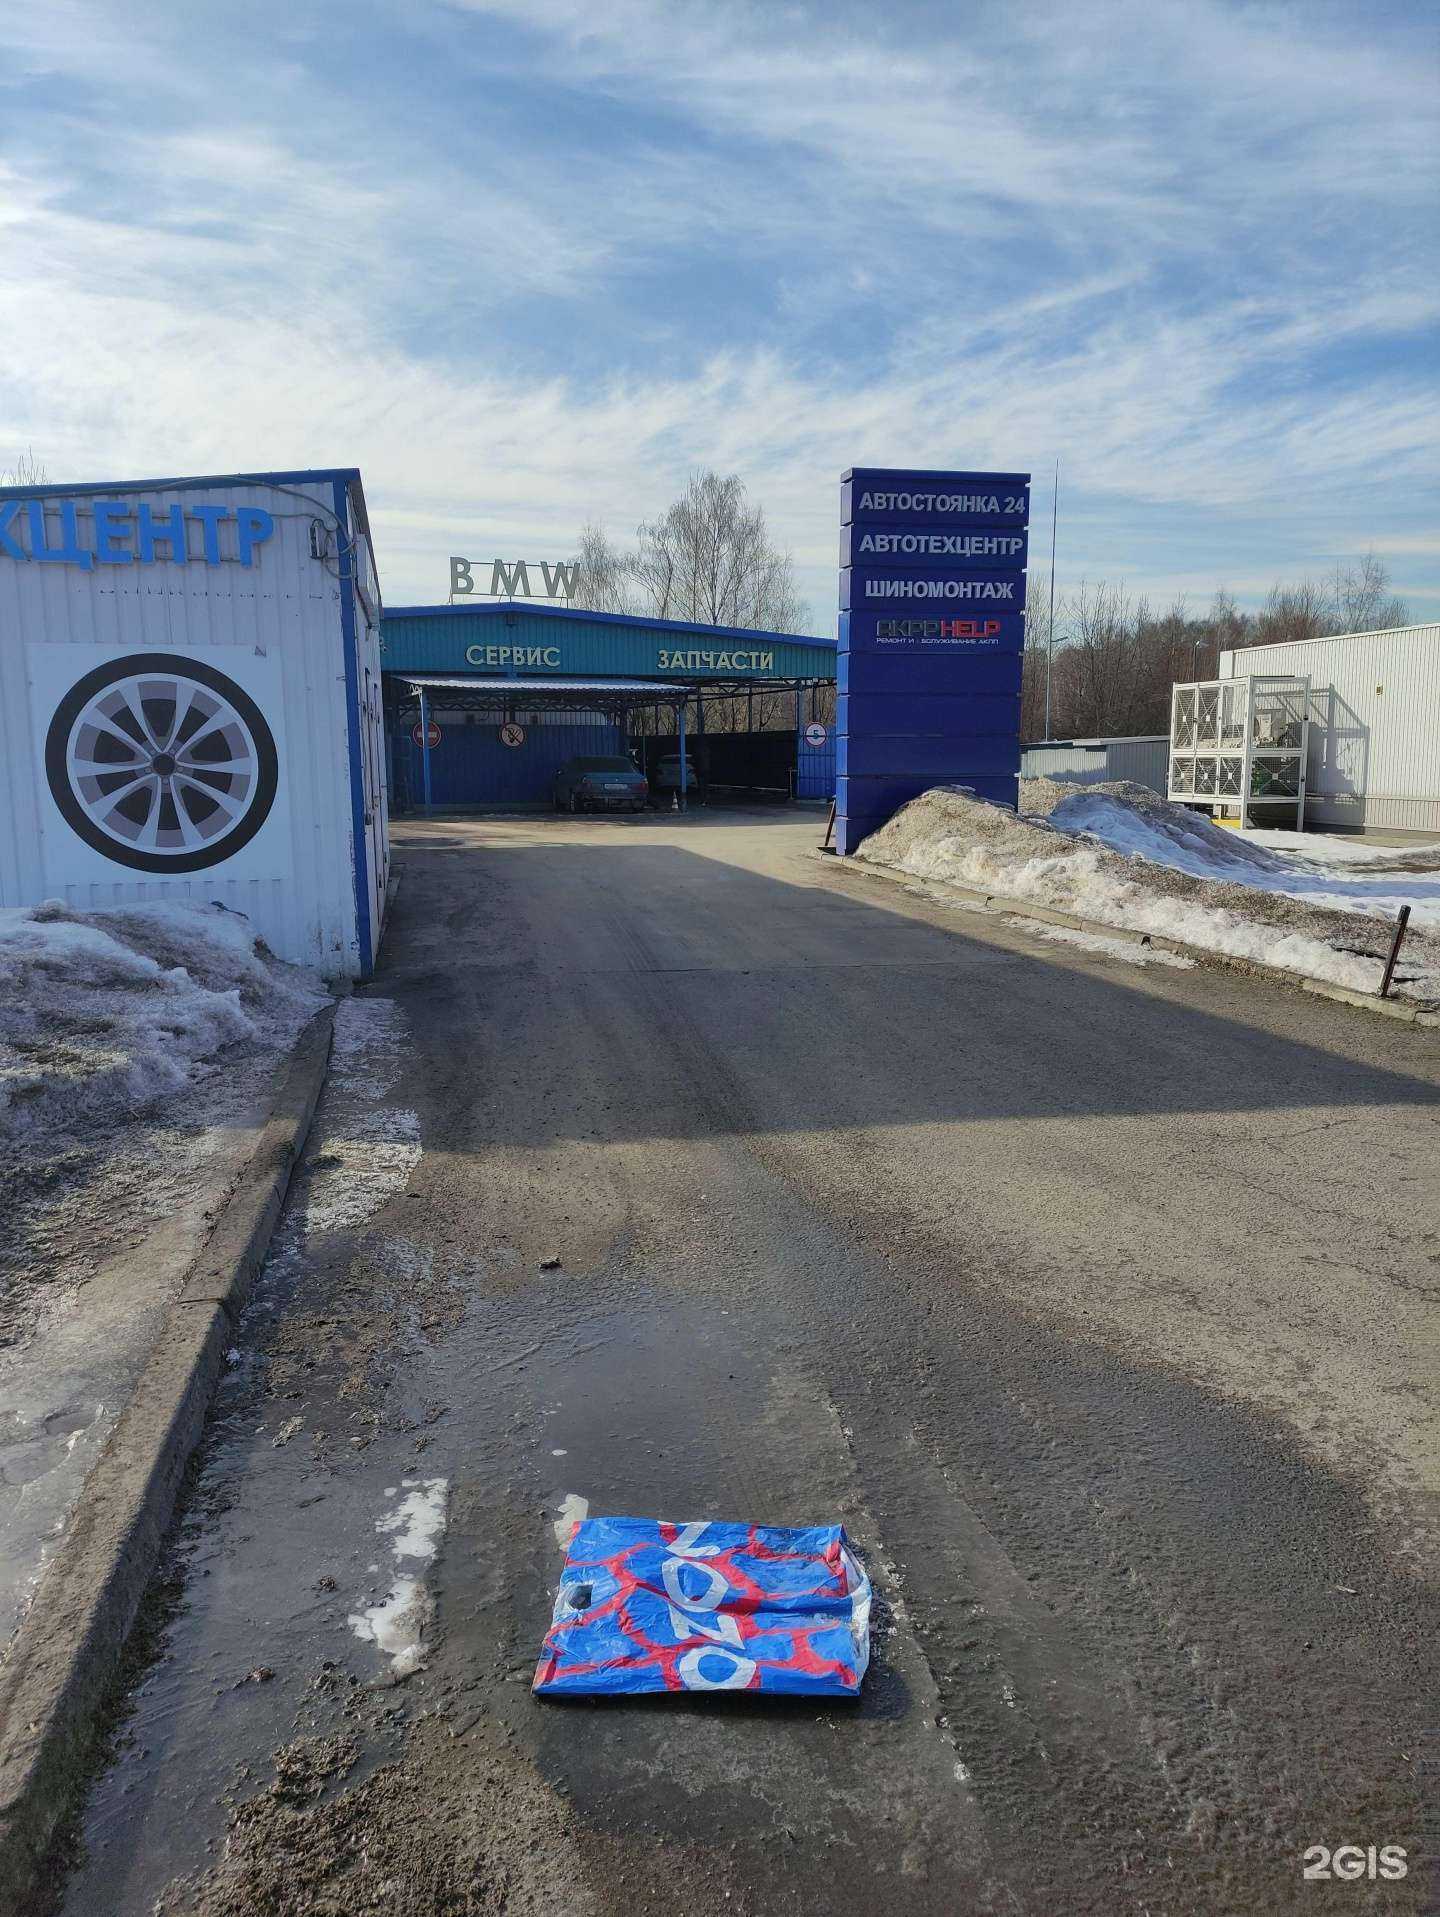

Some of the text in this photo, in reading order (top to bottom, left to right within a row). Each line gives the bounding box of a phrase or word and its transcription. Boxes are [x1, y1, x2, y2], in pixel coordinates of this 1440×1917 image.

[859, 492, 1026, 514] АВТОСТОЯНКА 24
[859, 534, 1024, 557] АВТОТЕХЦЕНТР
[450, 556, 581, 599] BMW
[865, 580, 1014, 599] ШИНОМОНТАЖ
[465, 644, 561, 667] СЕРВИС
[657, 649, 773, 671] ЗАПЧАСТИ
